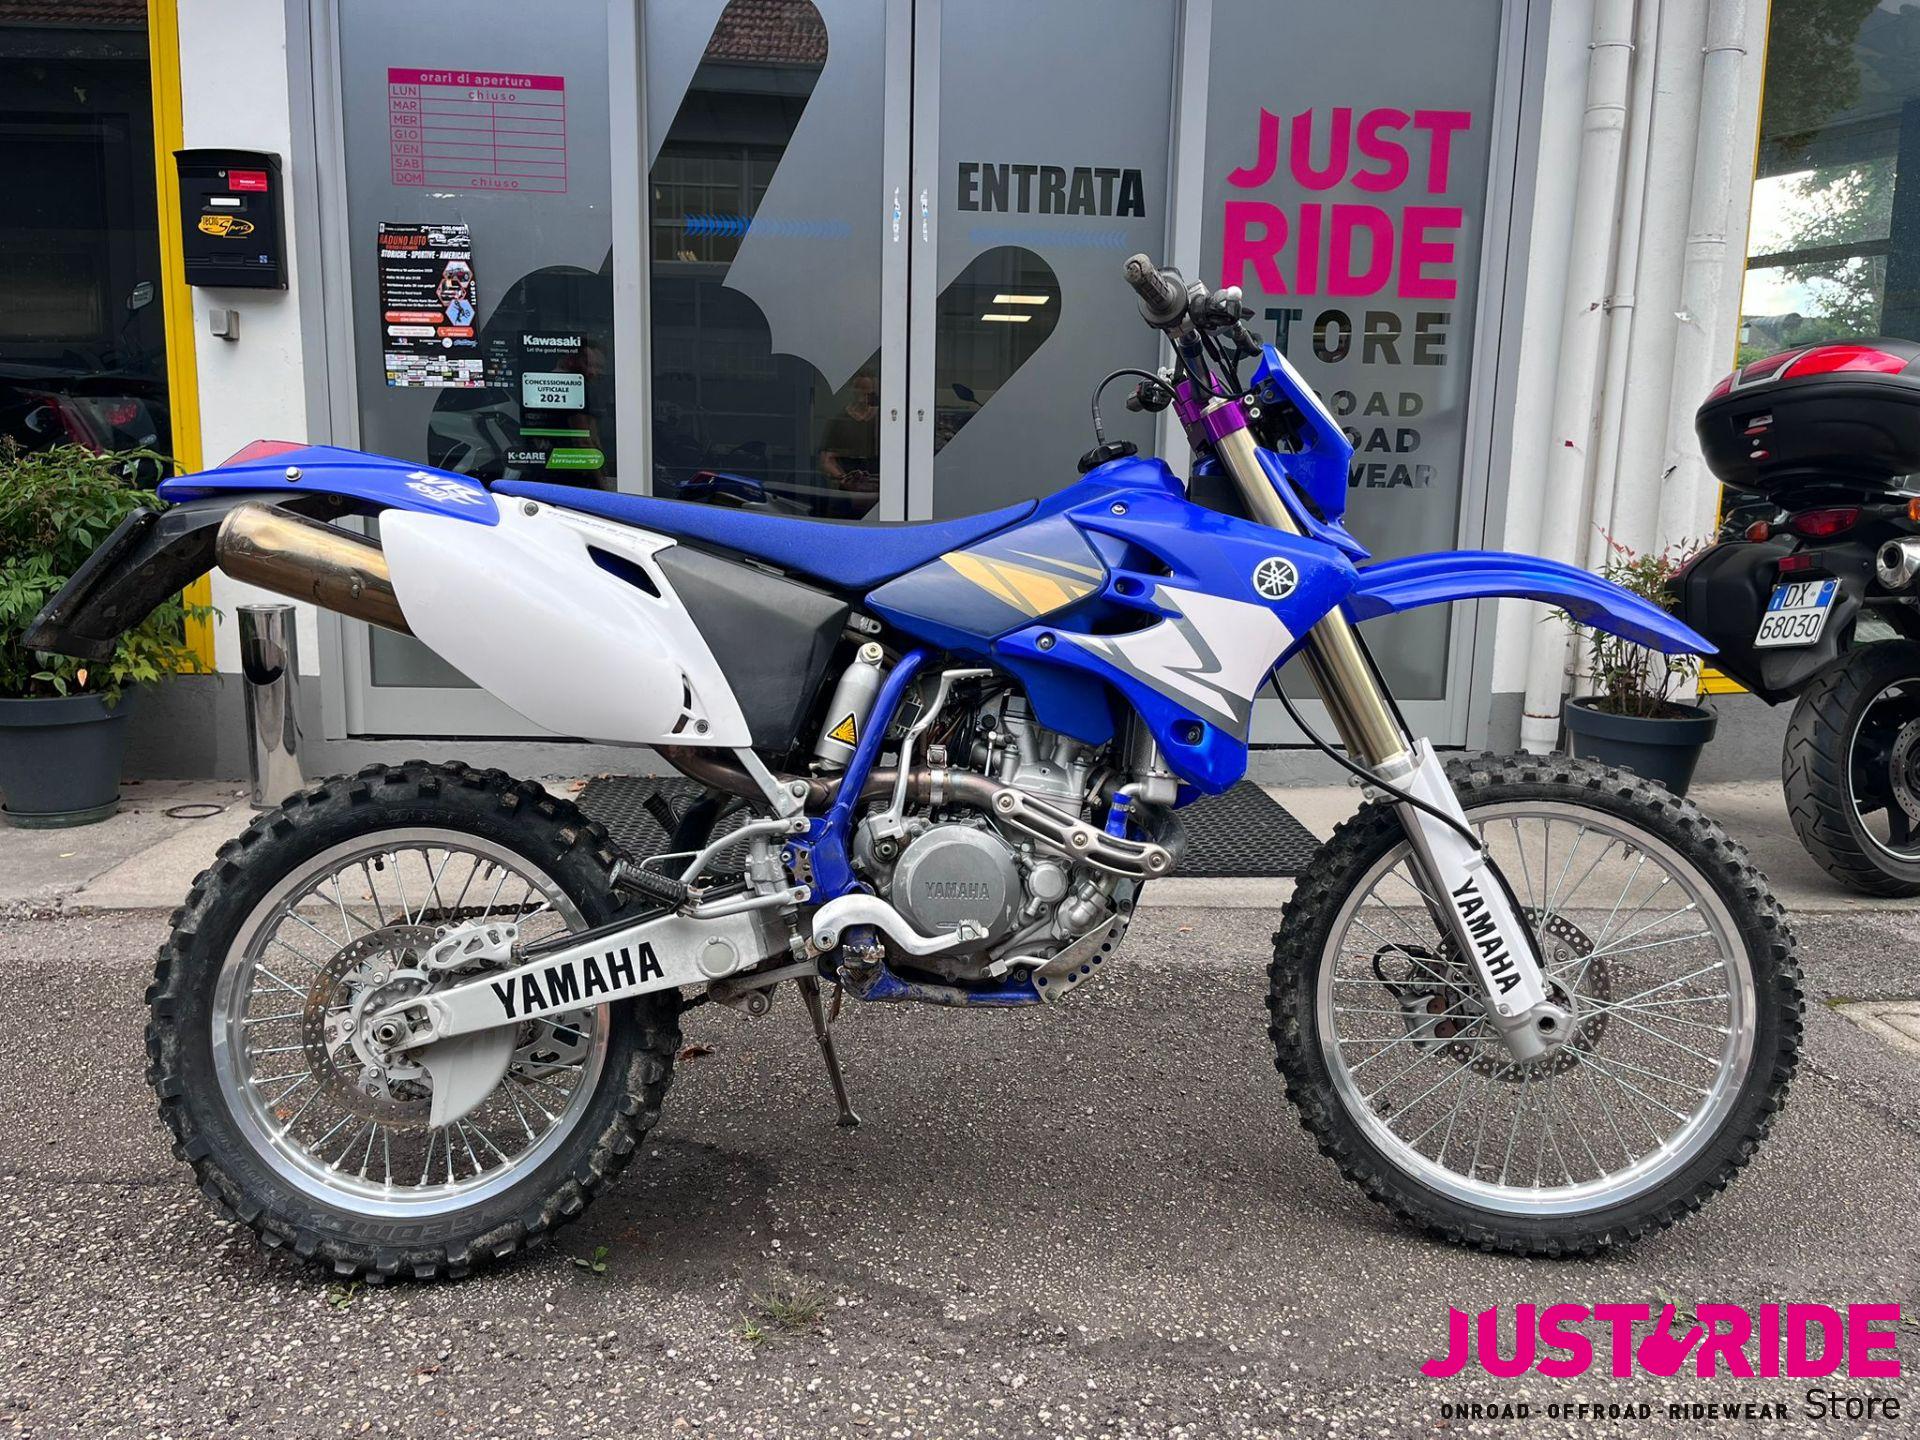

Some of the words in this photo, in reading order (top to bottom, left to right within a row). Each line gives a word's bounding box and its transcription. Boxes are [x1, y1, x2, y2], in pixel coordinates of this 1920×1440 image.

[419, 72, 452, 84] orari
[457, 74, 470, 85] di
[474, 76, 531, 88] apertura
[392, 86, 417, 97] LUN
[468, 91, 516, 102] chiuso
[393, 101, 417, 111] MAR
[393, 115, 417, 125] MER
[394, 130, 418, 140] GIO
[394, 144, 419, 154] VEN
[1226, 106, 1471, 194] JUST
[395, 159, 420, 169] SAB
[396, 173, 422, 183] DOM
[471, 178, 519, 188] chiuso
[957, 162, 1146, 217] ENTRATA
[409, 236, 427, 246] AUTO
[1221, 200, 1463, 299] RIDE
[523, 335, 581, 347] Kawasaki
[540, 394, 566, 403] 2021
[1782, 583, 1812, 608] DX
[1760, 614, 1821, 639] 68030
[925, 881, 990, 900] YAMAHA
[1452, 876, 1522, 996] YAMAHA
[491, 942, 665, 1019] YAMAHA
